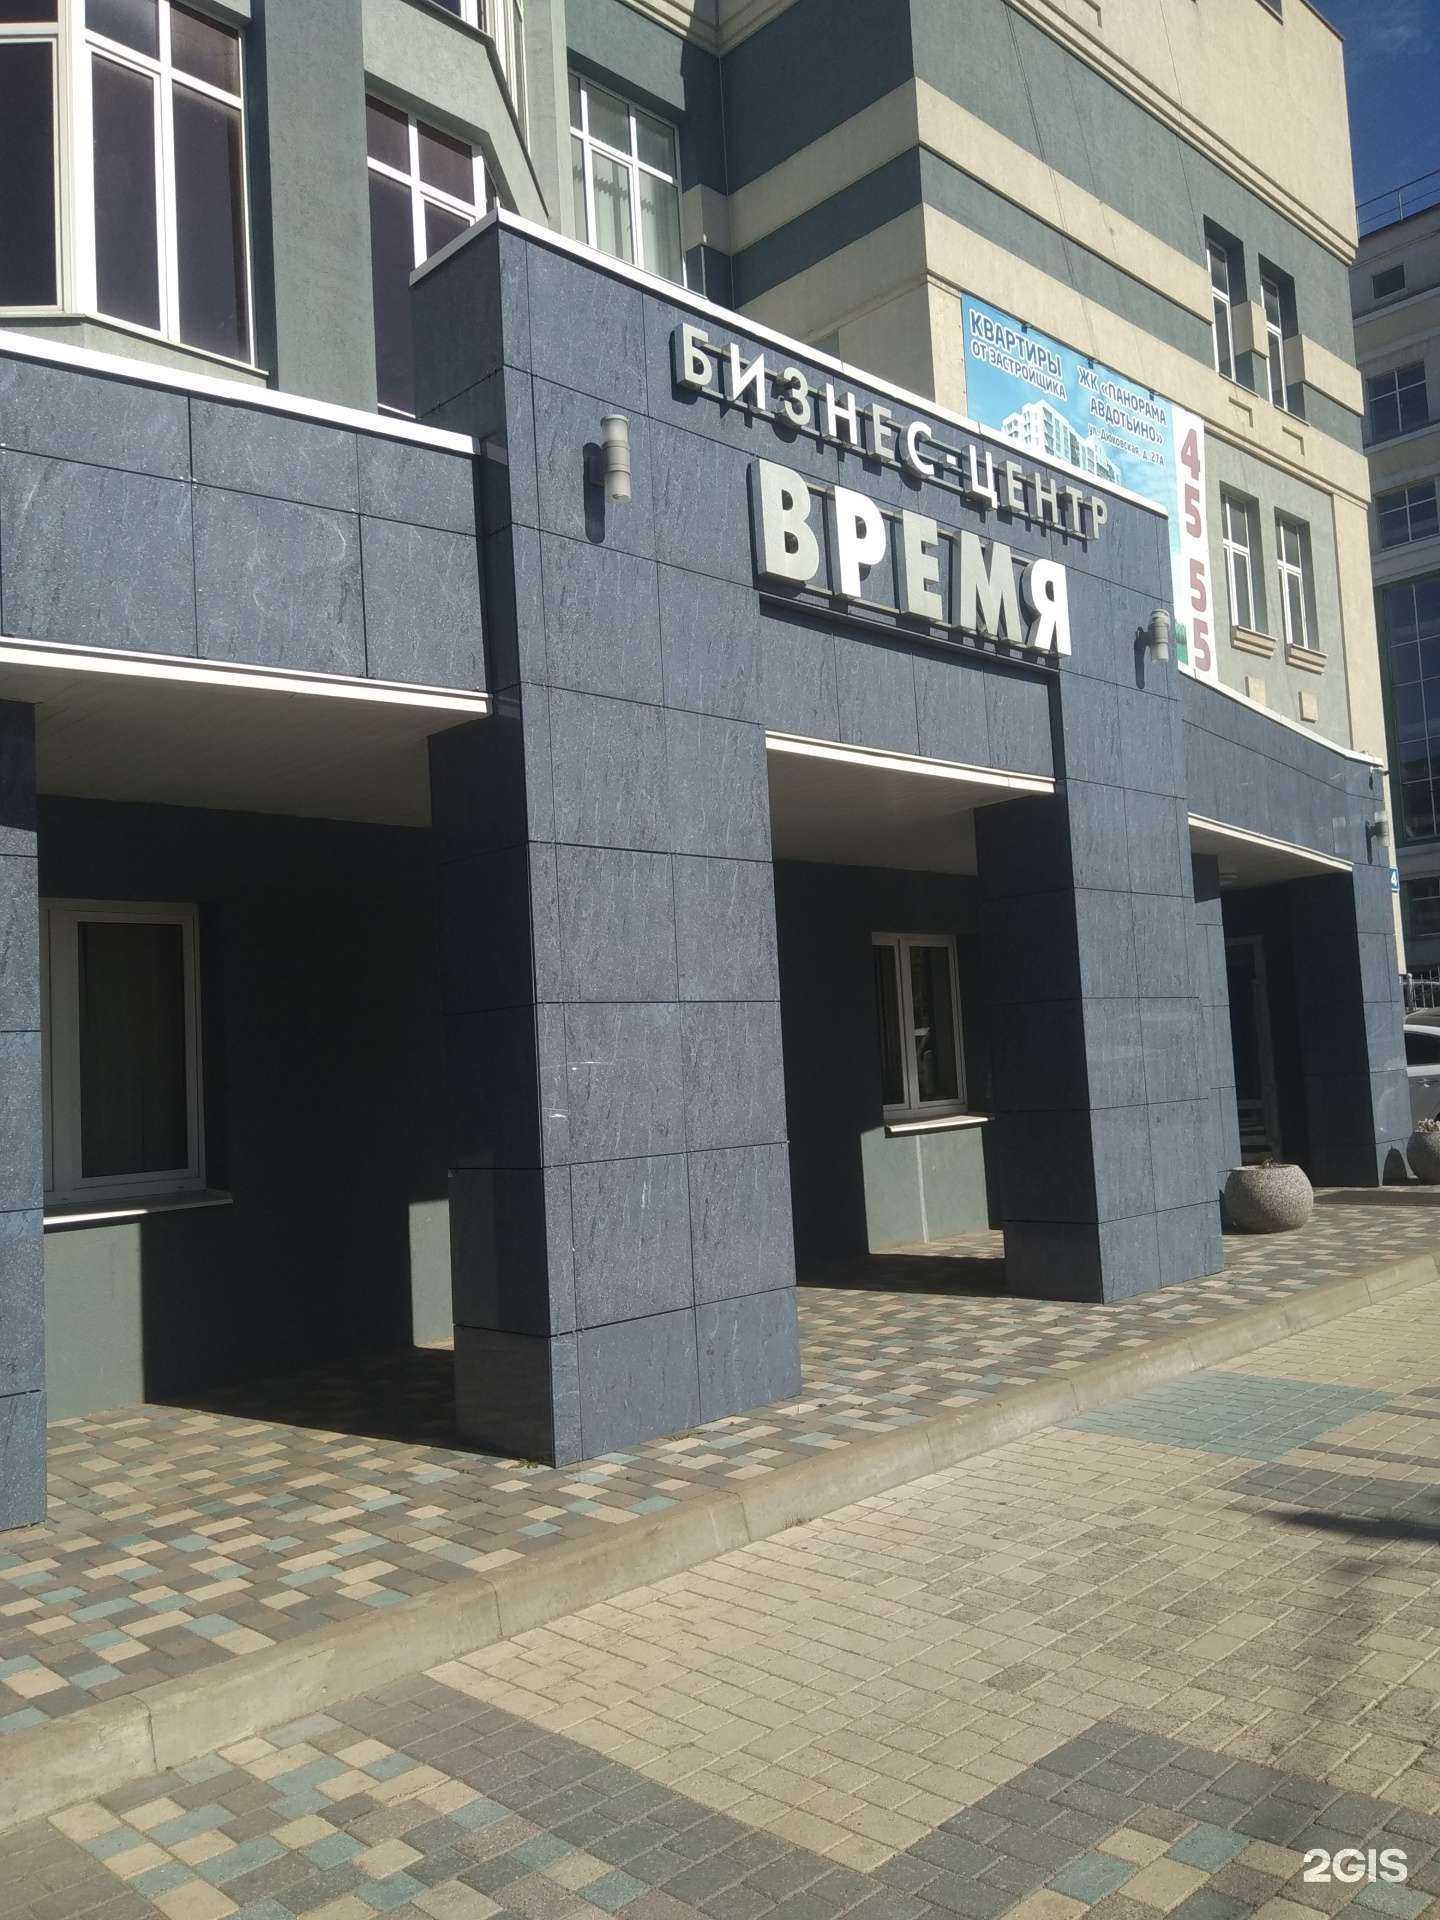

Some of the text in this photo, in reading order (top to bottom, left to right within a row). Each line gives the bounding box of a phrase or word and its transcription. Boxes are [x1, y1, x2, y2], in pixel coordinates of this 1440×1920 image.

[970, 311, 1062, 376] КВАРТИРЫ
[972, 342, 1066, 399] ОТ ЗАСТРОЙЩИКА
[1079, 368, 1166, 423] ЖК «ПАНОРАМА
[1090, 398, 1163, 444] АВДОТЬИНО»
[676, 322, 1108, 540] БИЗНЕС-ЦЕНТР
[748, 458, 1072, 658] ВРЕМЯ
